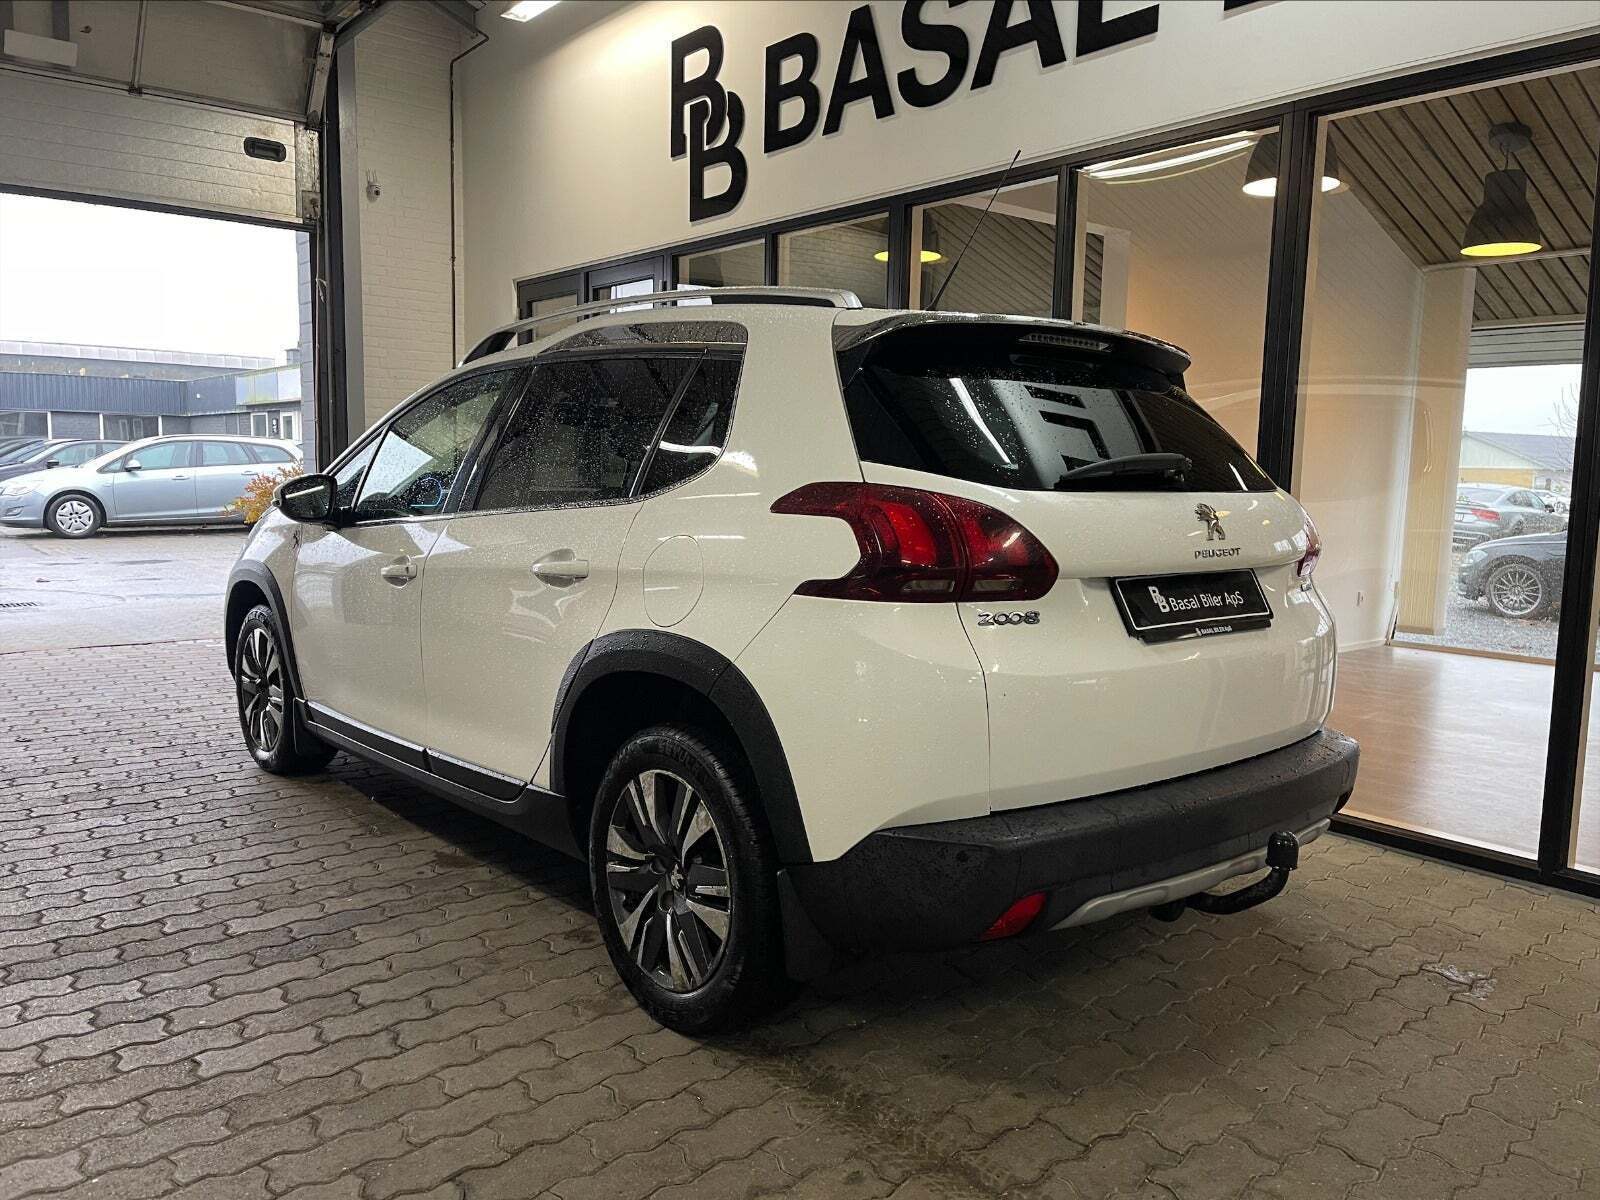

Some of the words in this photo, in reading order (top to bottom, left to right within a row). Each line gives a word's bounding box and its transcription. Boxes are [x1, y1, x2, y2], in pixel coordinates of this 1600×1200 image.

[1194, 547, 1241, 559] PEUGEOT
[1169, 595, 1201, 611] Basal
[1200, 593, 1224, 607] Biler
[1224, 591, 1244, 608] ApS
[977, 610, 1040, 626] 2008
